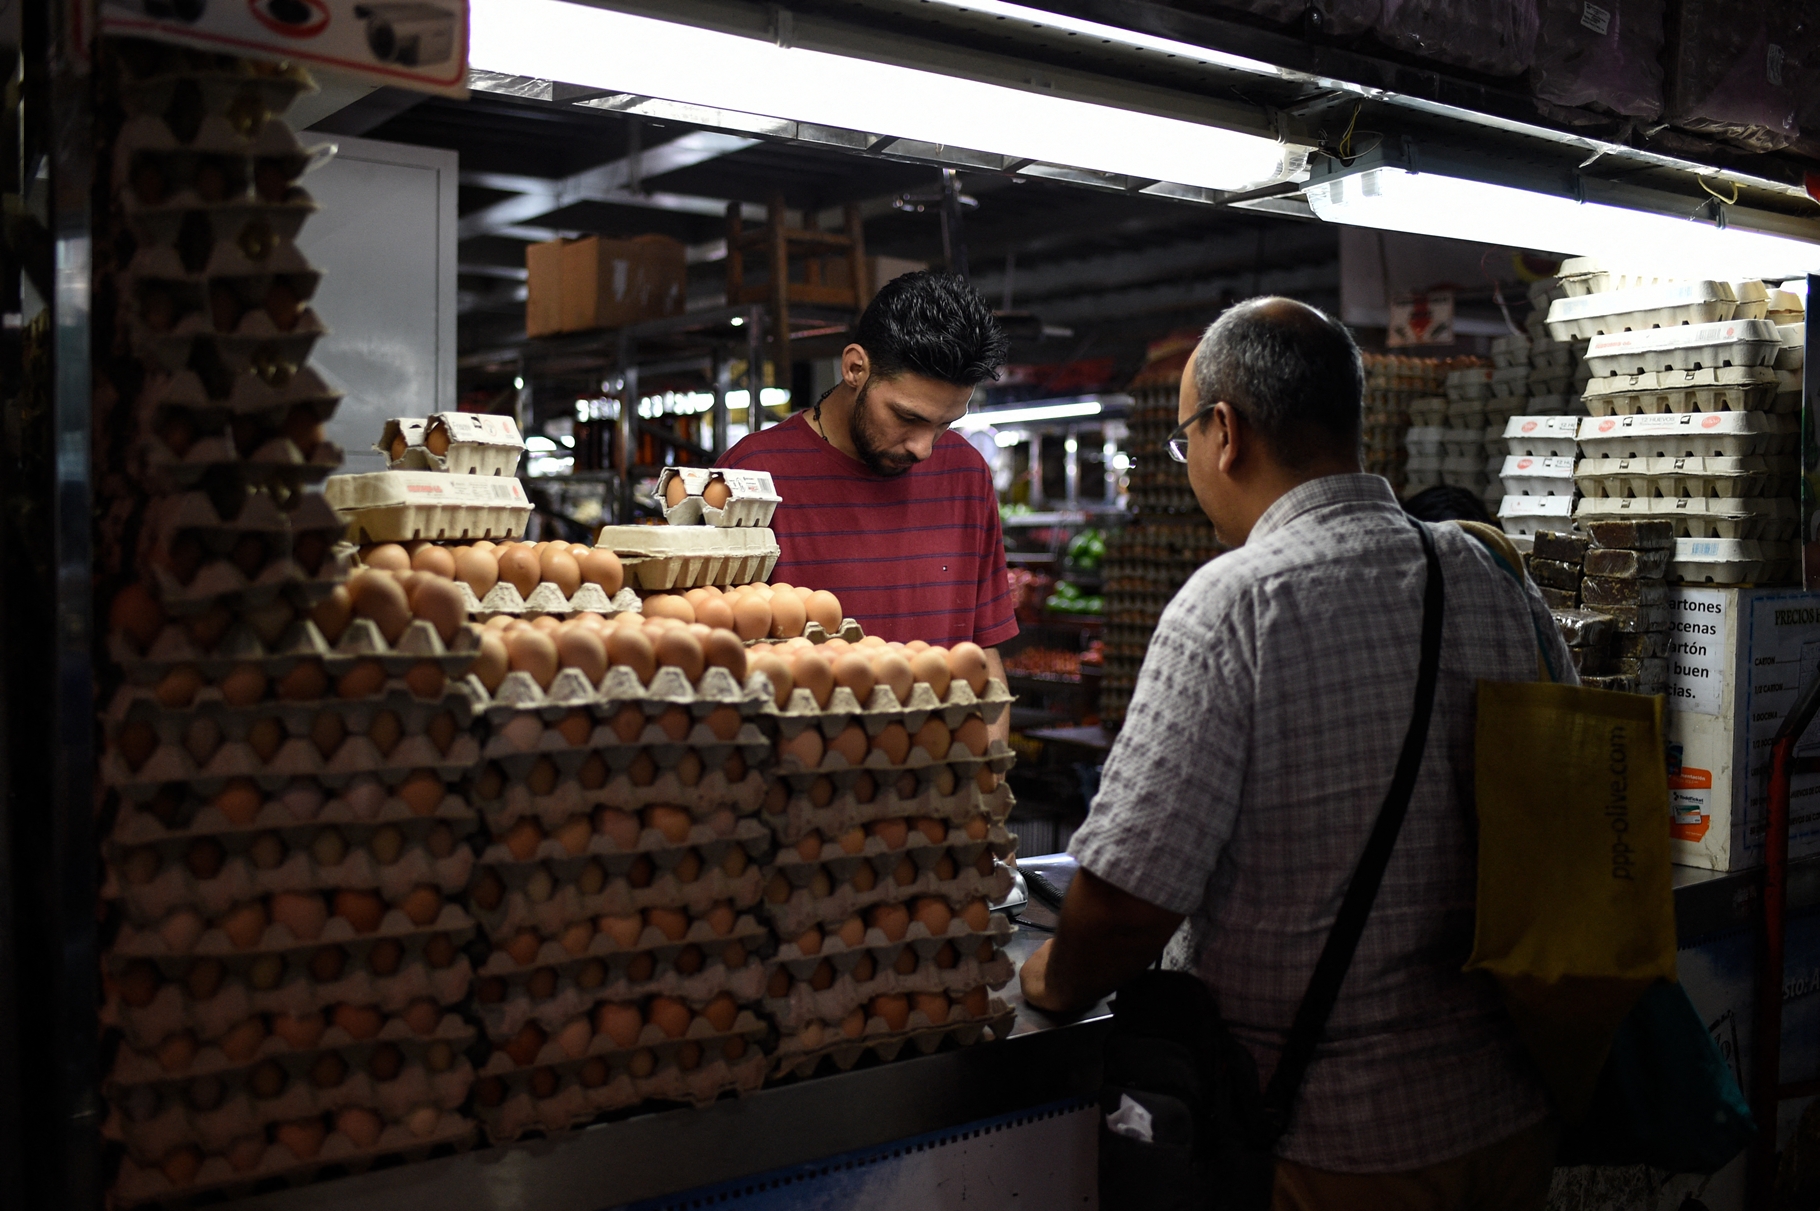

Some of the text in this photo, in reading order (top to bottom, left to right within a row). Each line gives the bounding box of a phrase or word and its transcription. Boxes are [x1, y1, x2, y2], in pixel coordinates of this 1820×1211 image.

[1775, 608, 1815, 626] PRECIOS
[1662, 641, 1707, 656] artón
[1754, 656, 1776, 666] CARTON
[1674, 661, 1709, 678] buen
[1754, 683, 1784, 695] 1/2 CARTON
[1756, 711, 1778, 721] DOCENA
[1782, 976, 1809, 1000] sto:
